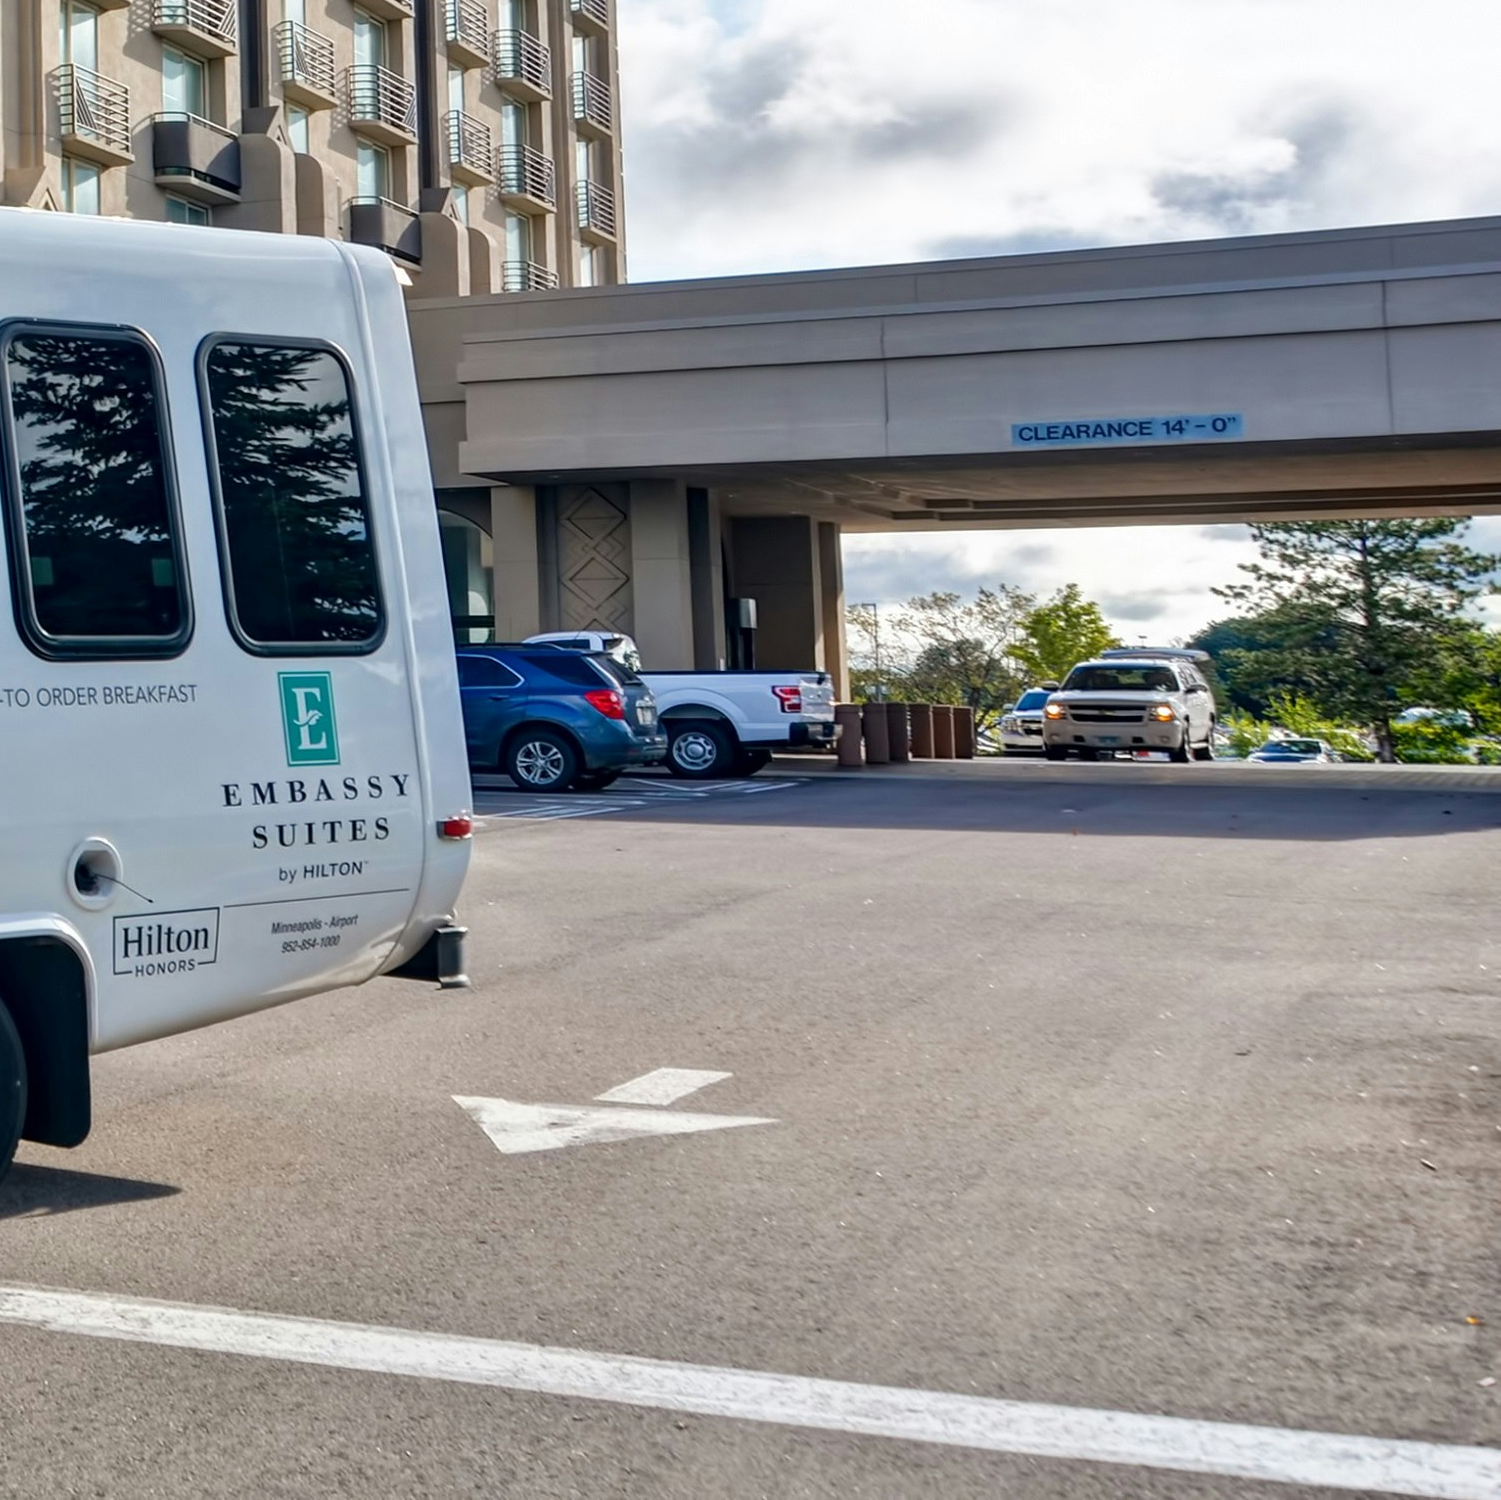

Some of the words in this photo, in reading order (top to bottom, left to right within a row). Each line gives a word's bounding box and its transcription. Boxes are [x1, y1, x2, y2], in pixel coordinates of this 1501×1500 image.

[1018, 421, 1153, 441] CLEARANCE
[1161, 419, 1190, 435] 14'
[36, 685, 98, 708] ORDER
[102, 684, 198, 706] BREAKFAST
[221, 774, 411, 808] EMBASSY
[252, 817, 390, 850] SUITES
[279, 868, 297, 884] by
[271, 919, 322, 934] Minneapolis
[329, 914, 359, 929] Airport
[122, 925, 209, 958] Hilton
[135, 959, 196, 978] HONORS
